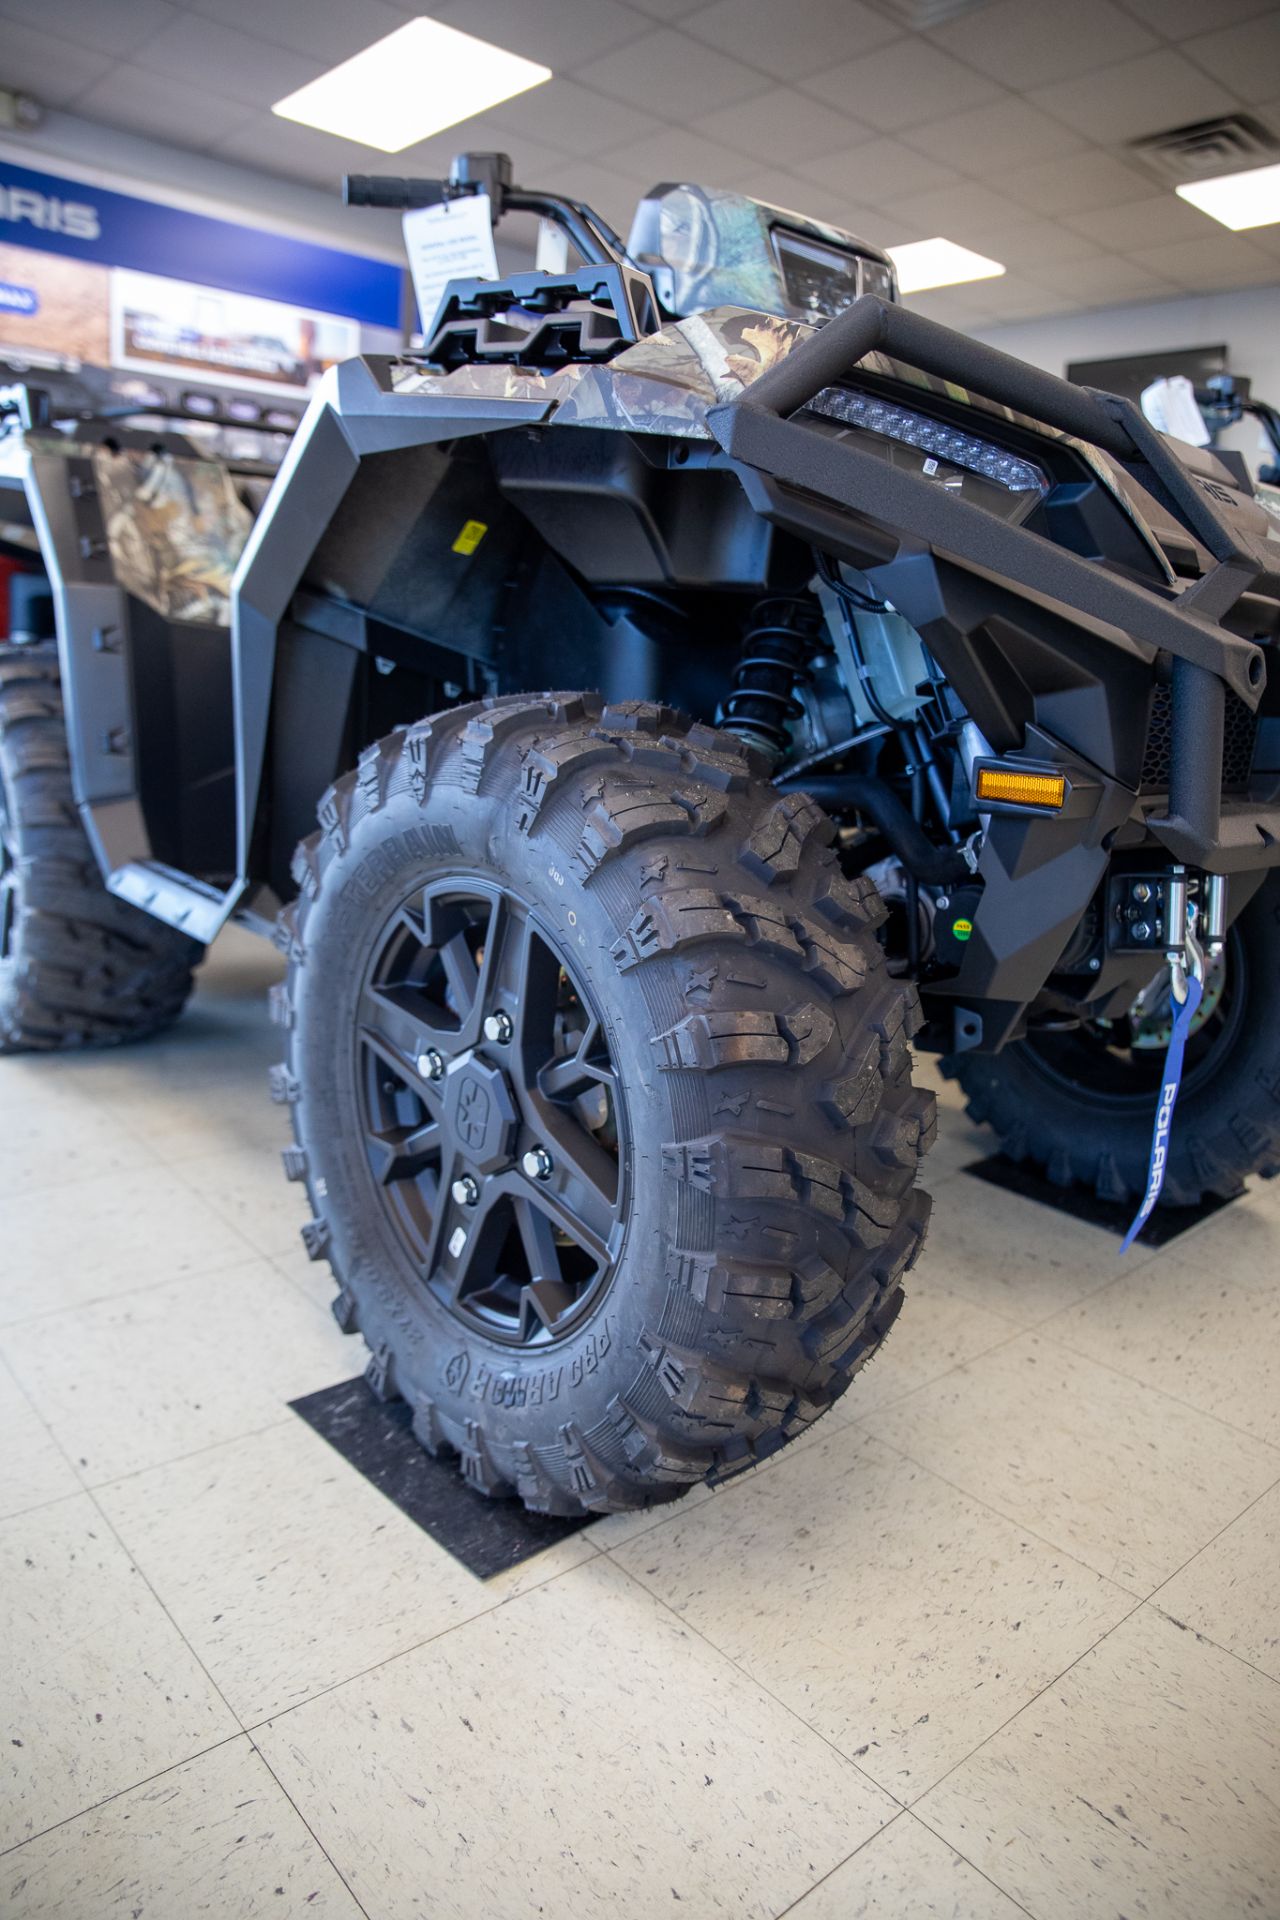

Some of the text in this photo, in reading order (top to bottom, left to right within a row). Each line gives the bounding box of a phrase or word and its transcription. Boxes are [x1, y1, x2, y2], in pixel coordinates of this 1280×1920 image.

[0, 184, 101, 241] RIS
[1139, 1082, 1177, 1218] POLARIS
[472, 1316, 612, 1409] PRO ARMOR
